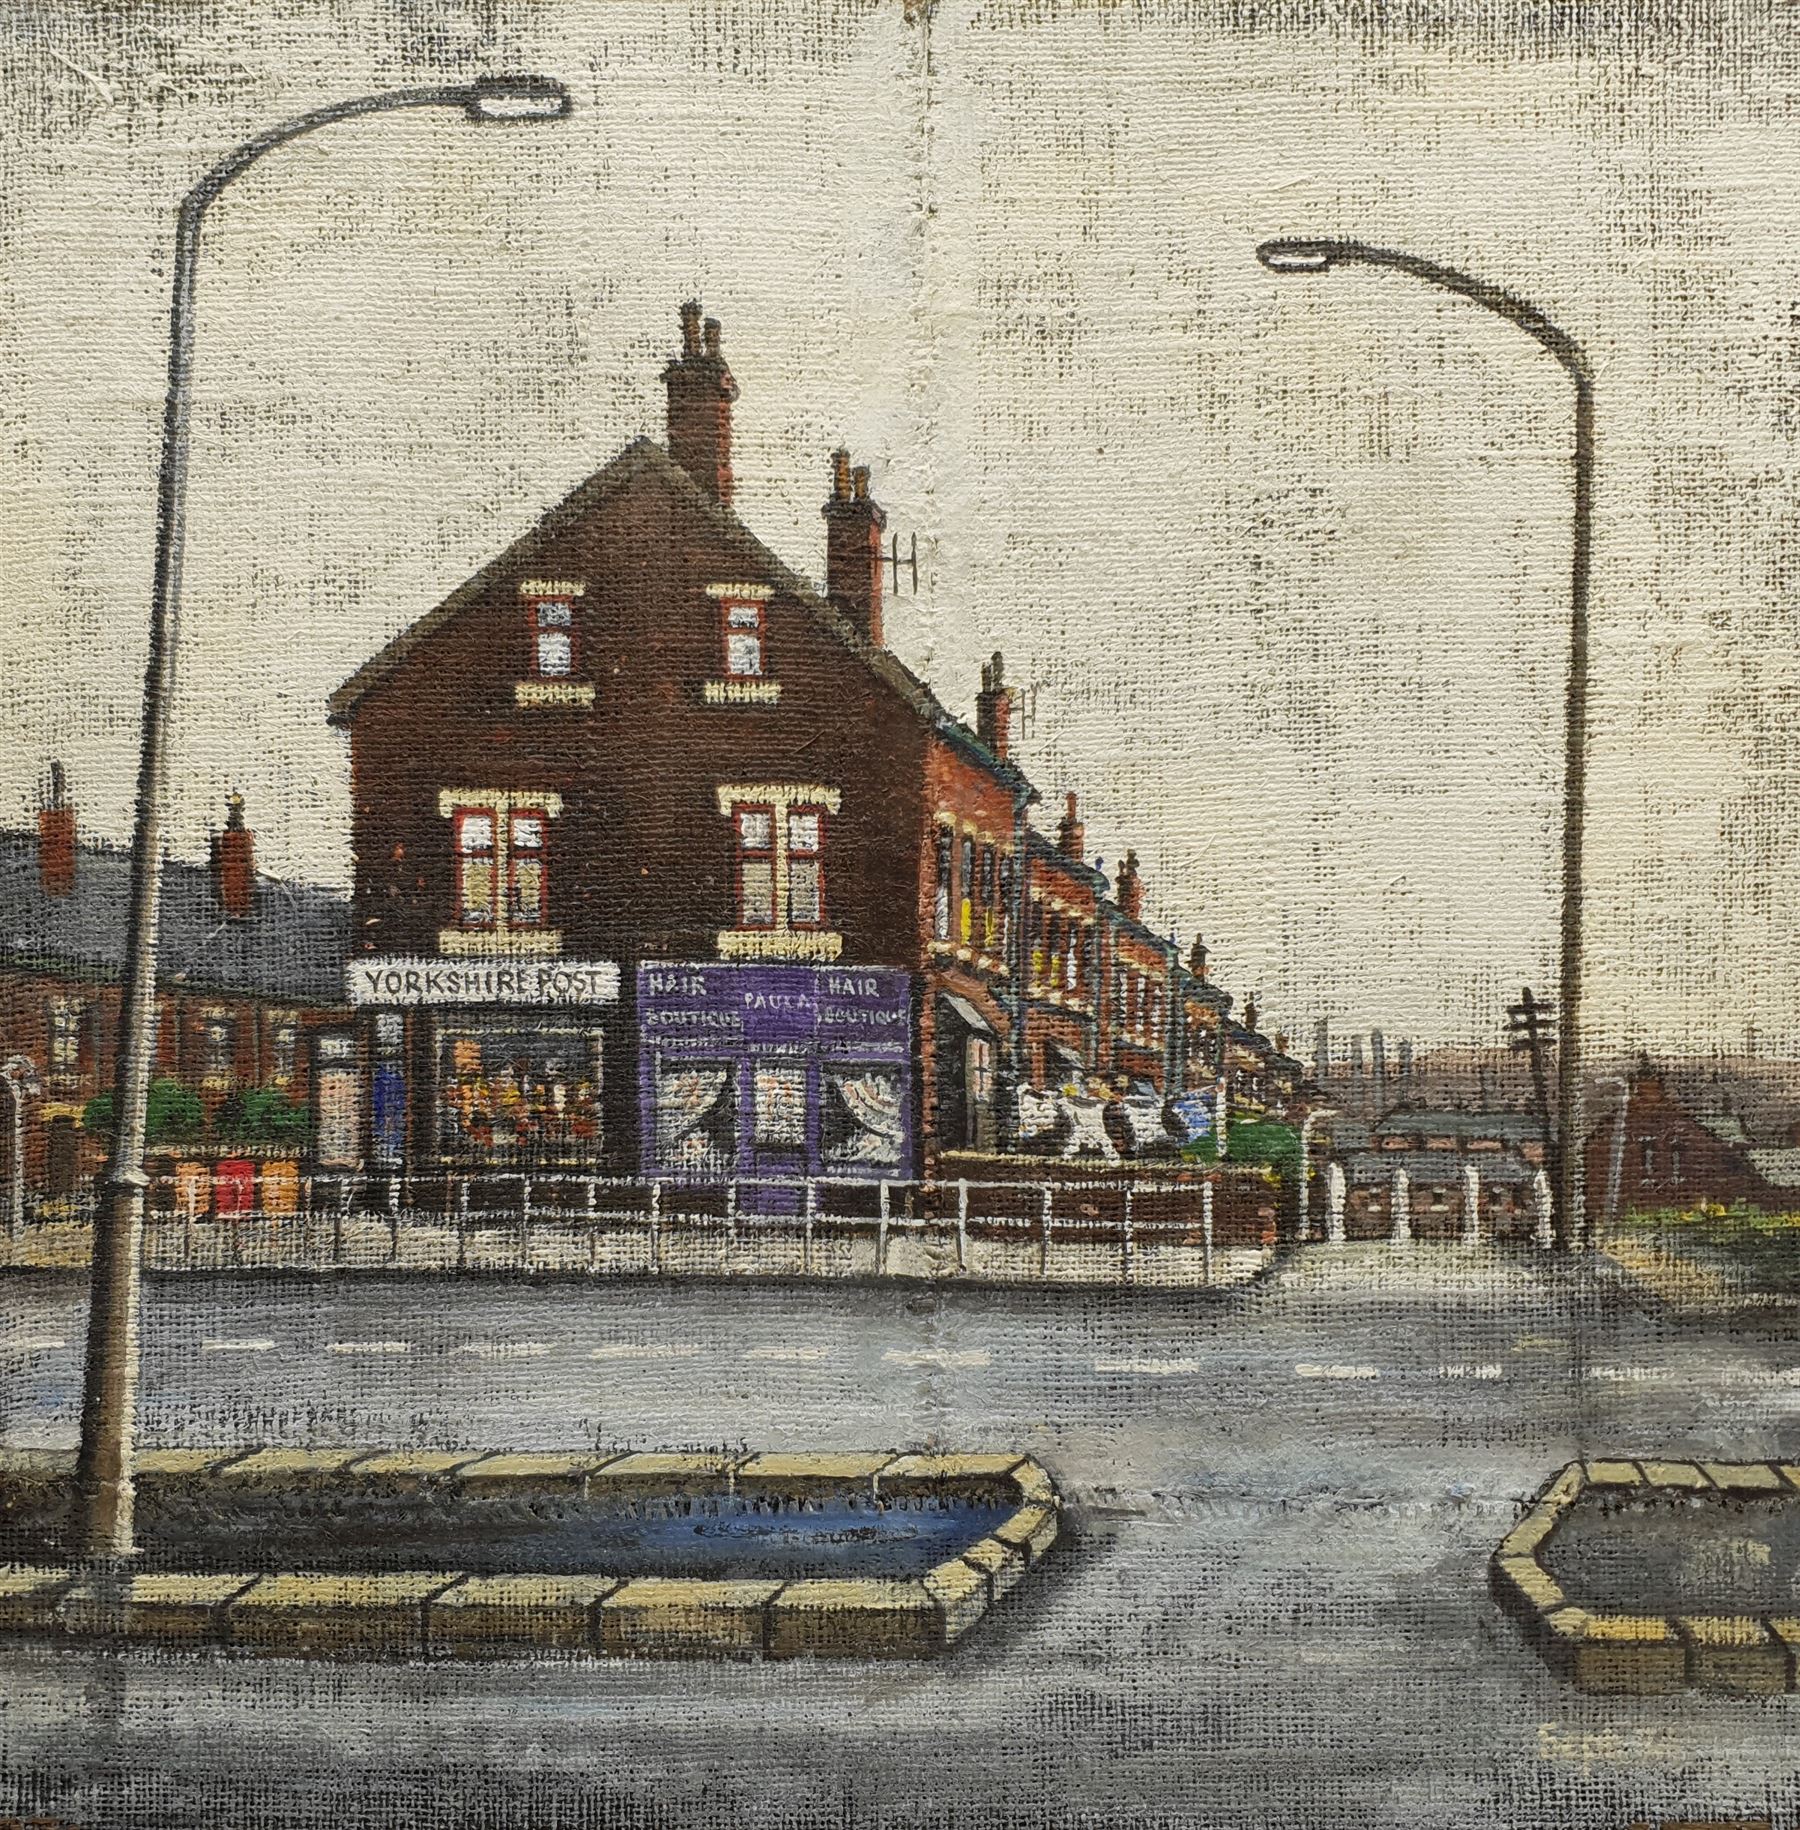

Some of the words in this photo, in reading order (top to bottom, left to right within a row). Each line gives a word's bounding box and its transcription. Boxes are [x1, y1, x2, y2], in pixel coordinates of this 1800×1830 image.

[364, 970, 527, 996] YORKSHIRE
[536, 969, 601, 997] POST
[649, 973, 708, 996] HAIR
[829, 977, 880, 998] HAIR
